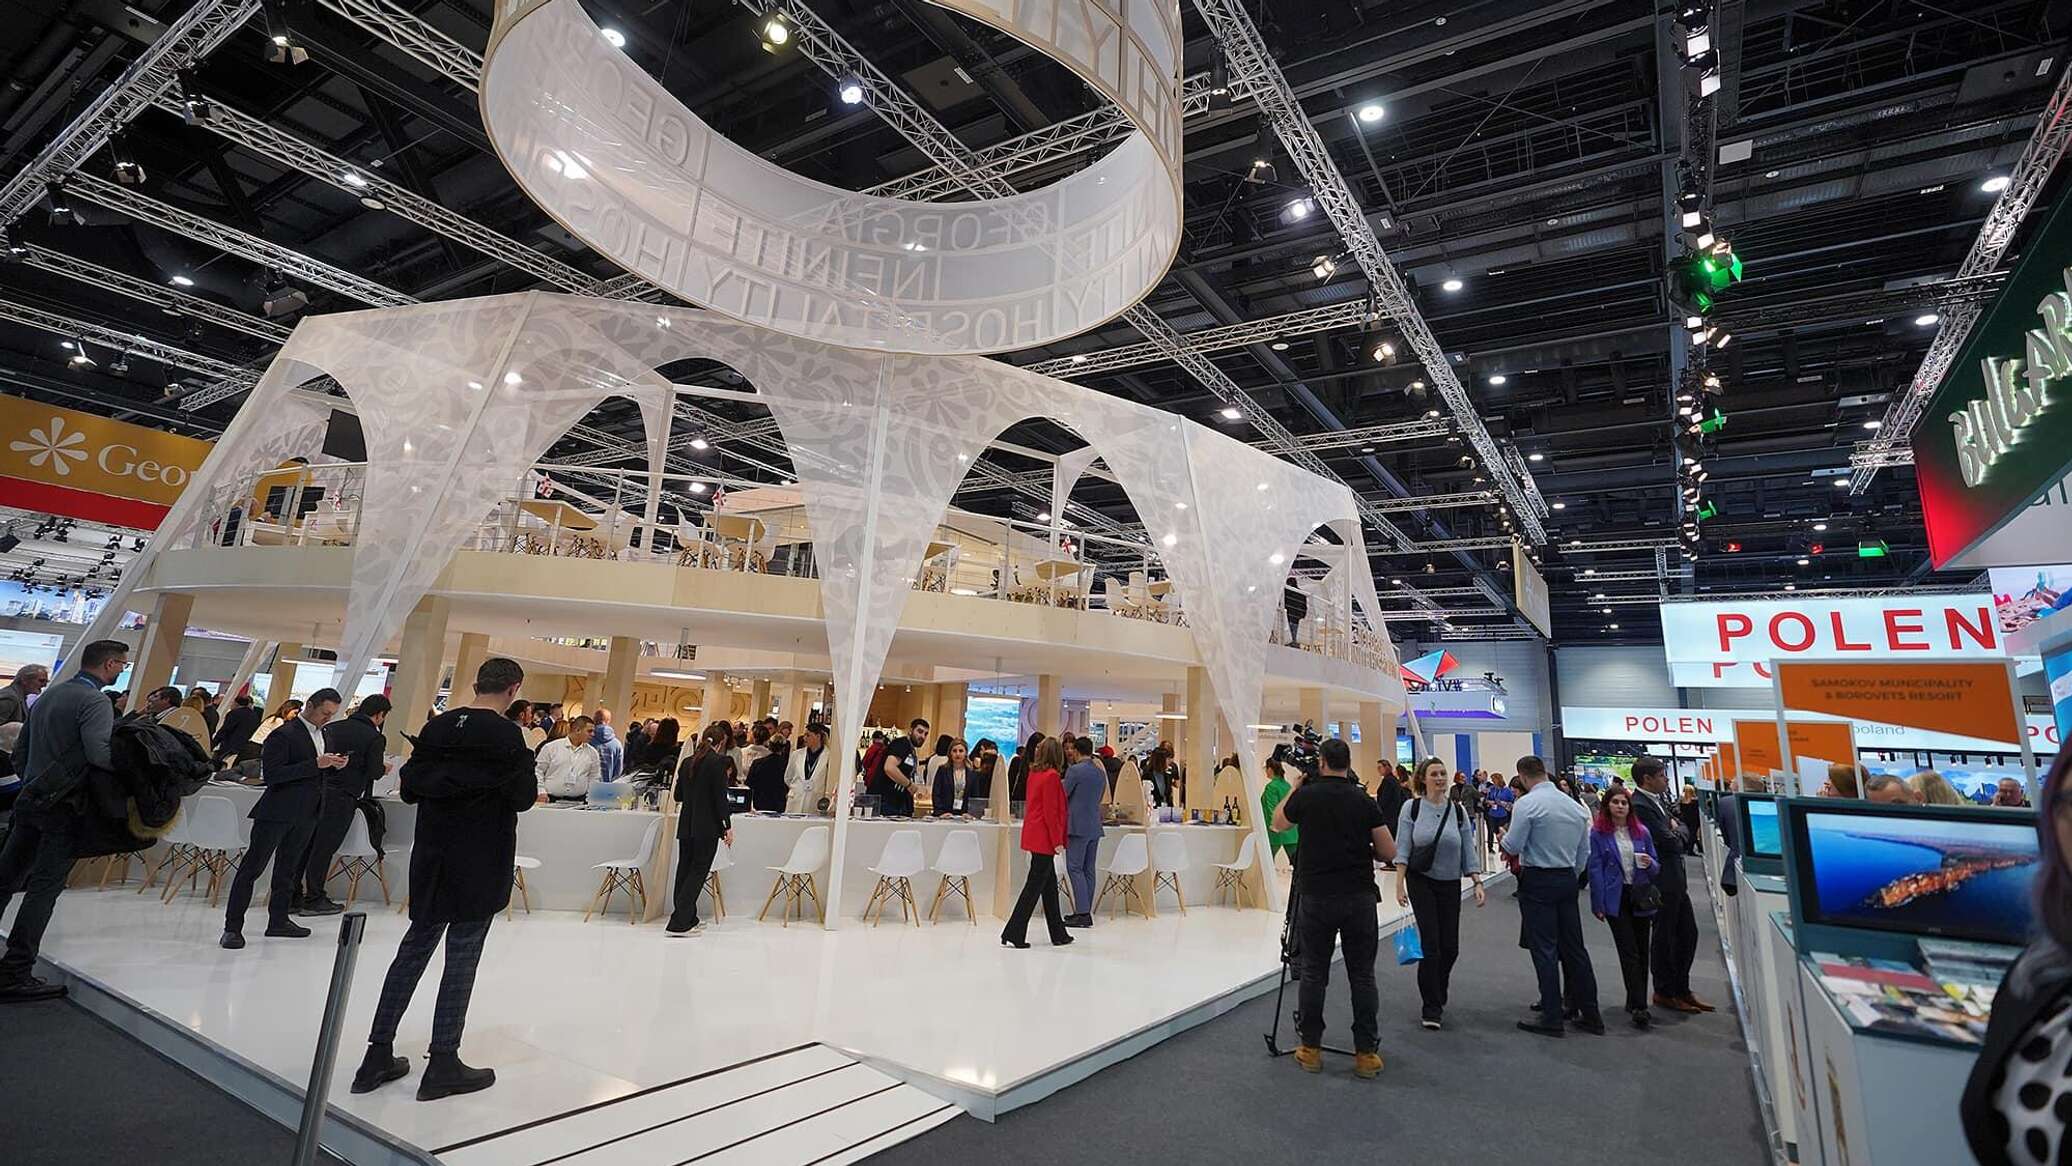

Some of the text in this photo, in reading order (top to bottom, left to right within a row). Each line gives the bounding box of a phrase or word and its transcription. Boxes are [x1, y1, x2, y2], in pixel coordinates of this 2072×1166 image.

[1948, 266, 2072, 488] BULGAR
[1717, 607, 1997, 652] POLEN
[1811, 678, 1974, 688] SAMOKOV MUNICIPALITY
[1836, 691, 1906, 700] BOROVETS
[1911, 691, 1963, 700] RESORT
[1626, 716, 1712, 733] POLEN
